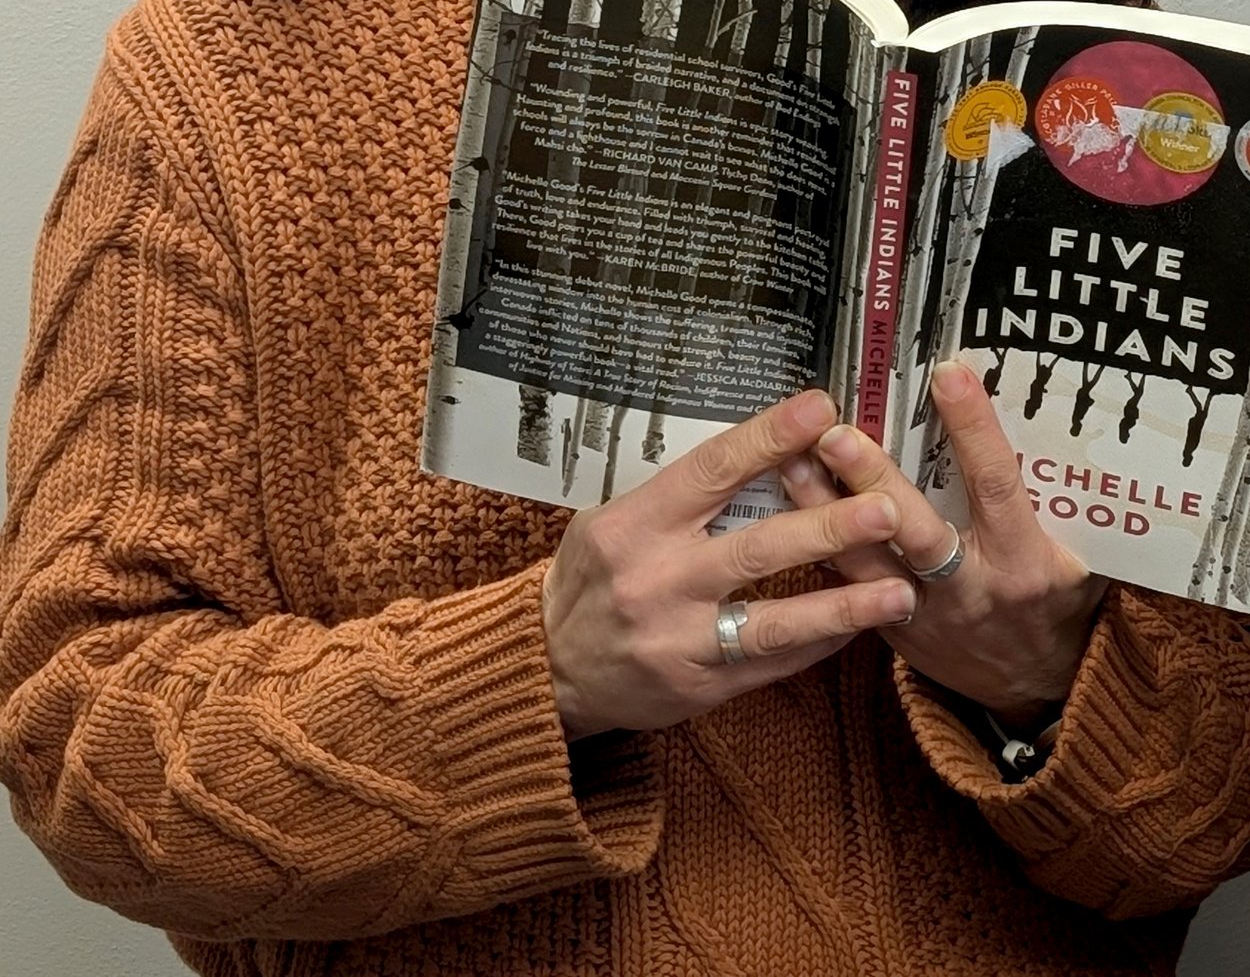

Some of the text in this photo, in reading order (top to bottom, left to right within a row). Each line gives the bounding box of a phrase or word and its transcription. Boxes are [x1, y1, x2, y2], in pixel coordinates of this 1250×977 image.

[579, 37, 596, 47] the
[622, 45, 634, 54] of
[634, 49, 686, 62] residential
[688, 56, 719, 67] school
[580, 50, 620, 65] triumph
[622, 57, 634, 66] of
[635, 58, 672, 72] braided
[548, 61, 567, 70] and
[693, 82, 732, 98] BAKER,
[586, 93, 606, 102] and
[889, 78, 911, 131] FIVE
[512, 108, 548, 119] schools
[617, 123, 634, 133] the
[520, 121, 546, 133] force
[548, 127, 567, 136] and
[564, 103, 583, 112] and
[635, 113, 654, 123] this
[655, 115, 680, 127] book
[691, 124, 730, 136] another
[658, 156, 682, 167] VAN
[883, 138, 905, 210] LITTLE
[502, 185, 514, 194] of
[545, 191, 566, 202] love
[567, 197, 586, 206] and
[694, 202, 730, 215] elegant
[732, 209, 750, 218] and
[529, 214, 556, 226] Good
[558, 222, 585, 232] pours
[586, 227, 605, 236] you
[615, 232, 634, 243] cup
[665, 238, 684, 247] and
[686, 240, 715, 252] shares
[736, 250, 778, 264] powerful
[592, 215, 616, 224] your
[617, 216, 642, 228] hand
[690, 230, 709, 239] you
[538, 229, 559, 240] that
[614, 244, 646, 255] stories
[648, 249, 660, 257] of
[660, 250, 673, 259] all
[1049, 226, 1185, 282] FIVE
[873, 220, 898, 312] INDIANS
[511, 262, 530, 272] this
[574, 273, 603, 287] debut
[635, 285, 678, 299] Michelle
[680, 291, 708, 303] Good
[501, 298, 537, 312] Canada
[580, 301, 622, 317] Michelle
[623, 310, 653, 322] shows
[586, 289, 696, 314] into the human cost of
[1013, 266, 1210, 332] LITTLE
[501, 322, 577, 346] those who never
[602, 333, 622, 342] and
[975, 306, 1236, 381] INDIANS
[863, 319, 890, 426] MICHELLE
[1016, 452, 1203, 518] ICHELLE
